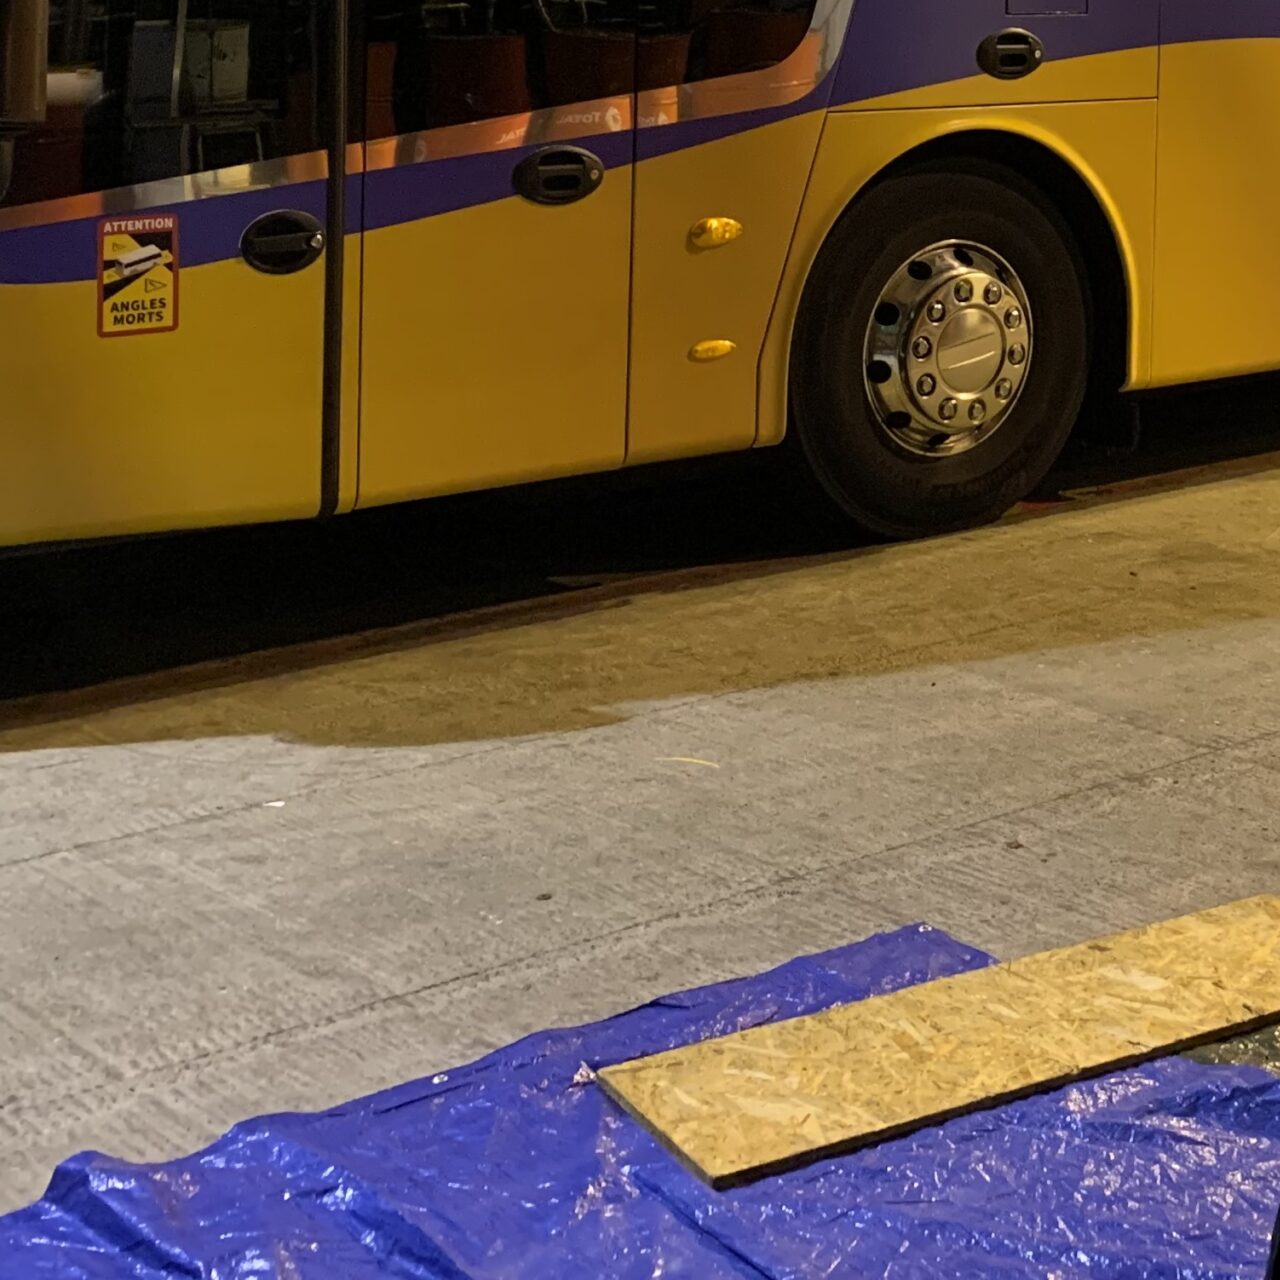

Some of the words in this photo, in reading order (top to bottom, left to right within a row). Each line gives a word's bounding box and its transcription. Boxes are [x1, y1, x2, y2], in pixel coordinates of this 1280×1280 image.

[103, 218, 173, 233] ATTENTION
[110, 297, 167, 313] ANGLES
[113, 311, 164, 326] MORTS
